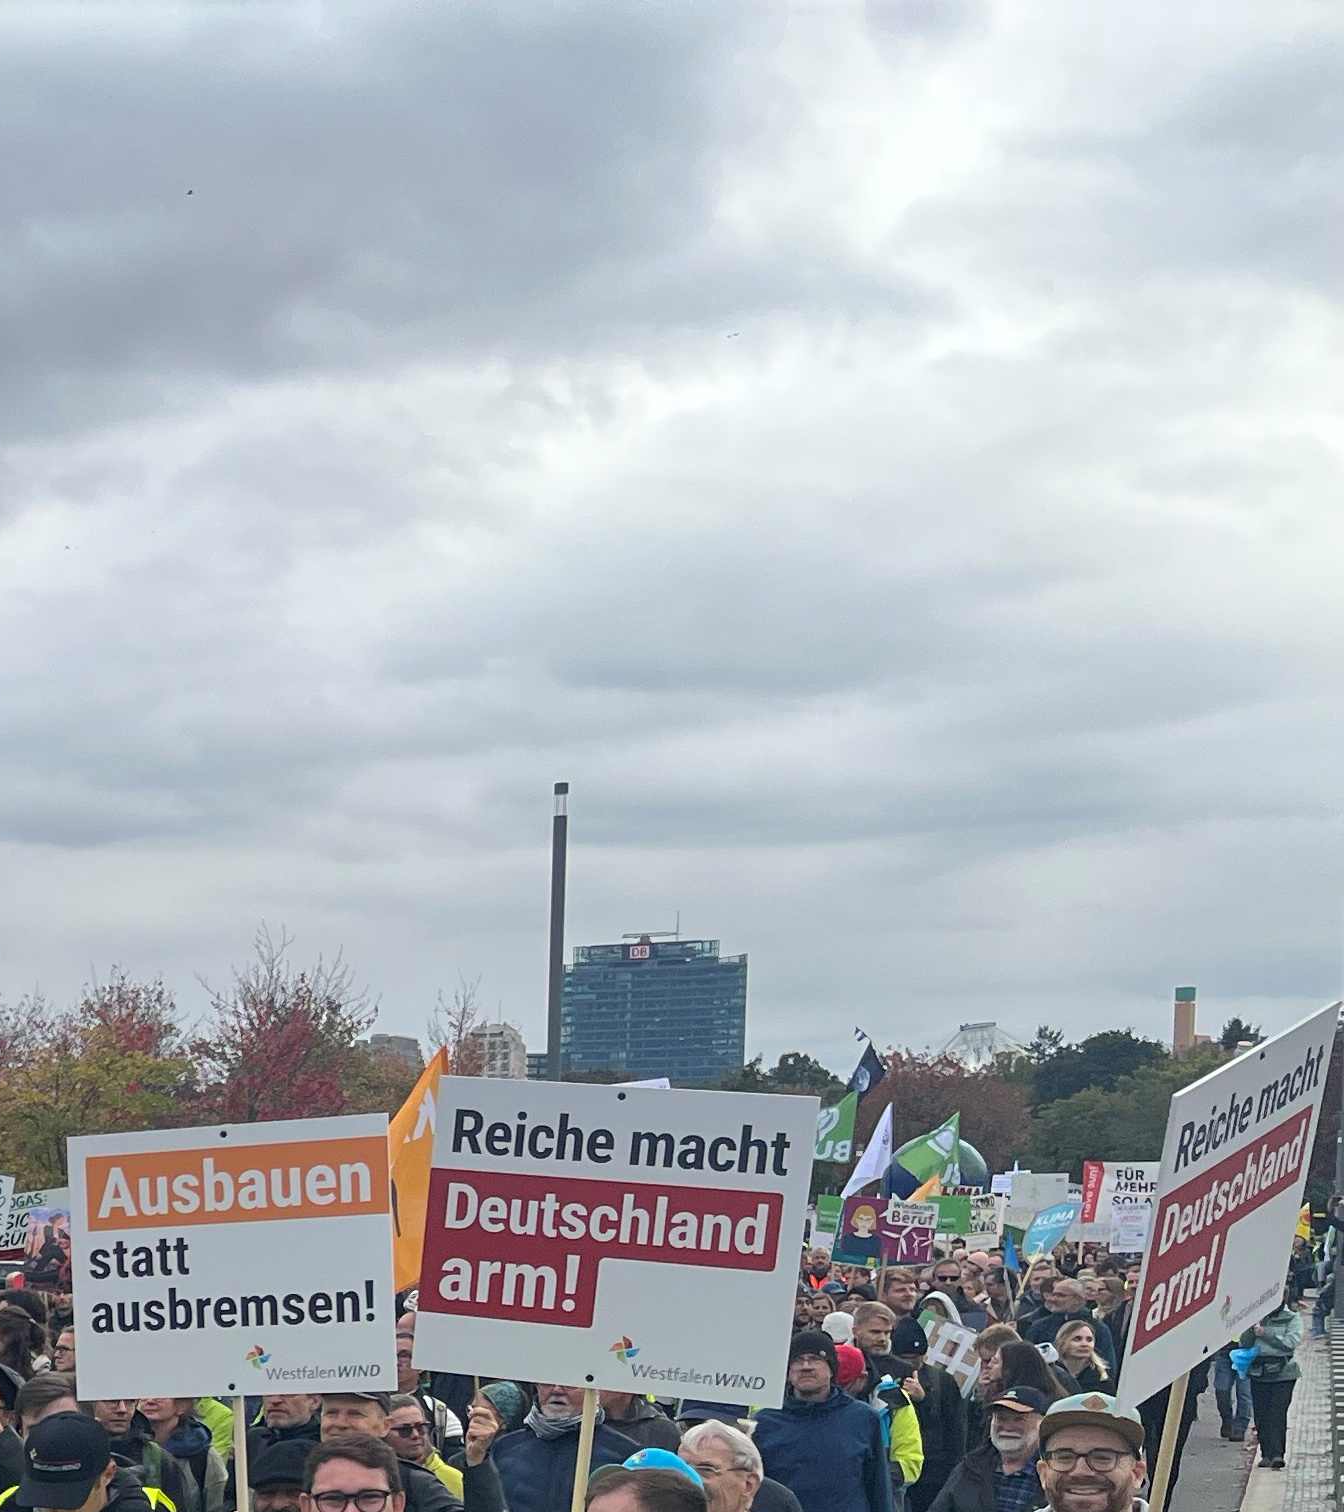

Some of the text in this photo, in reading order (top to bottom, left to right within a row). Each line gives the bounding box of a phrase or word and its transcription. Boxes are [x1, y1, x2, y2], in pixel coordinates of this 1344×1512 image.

[631, 946, 648, 958] DB
[1174, 1045, 1324, 1173] Reiche macht
[452, 1109, 790, 1176] Reiche macht
[98, 1158, 371, 1219] Ausbauen
[1116, 1167, 1144, 1181] FÜR
[1158, 1119, 1307, 1257] Deutschland
[444, 1182, 768, 1255] Deutschland
[892, 1210, 935, 1226] Beruf
[1034, 1209, 1074, 1227] KLIMA
[89, 1237, 190, 1280] statt
[438, 1255, 581, 1312] arm!
[1145, 1233, 1220, 1332] arm!
[92, 1280, 375, 1333] ausbremsen!
[267, 1364, 380, 1381] WestfalenWIND
[632, 1362, 766, 1391] WestfalenWIND
